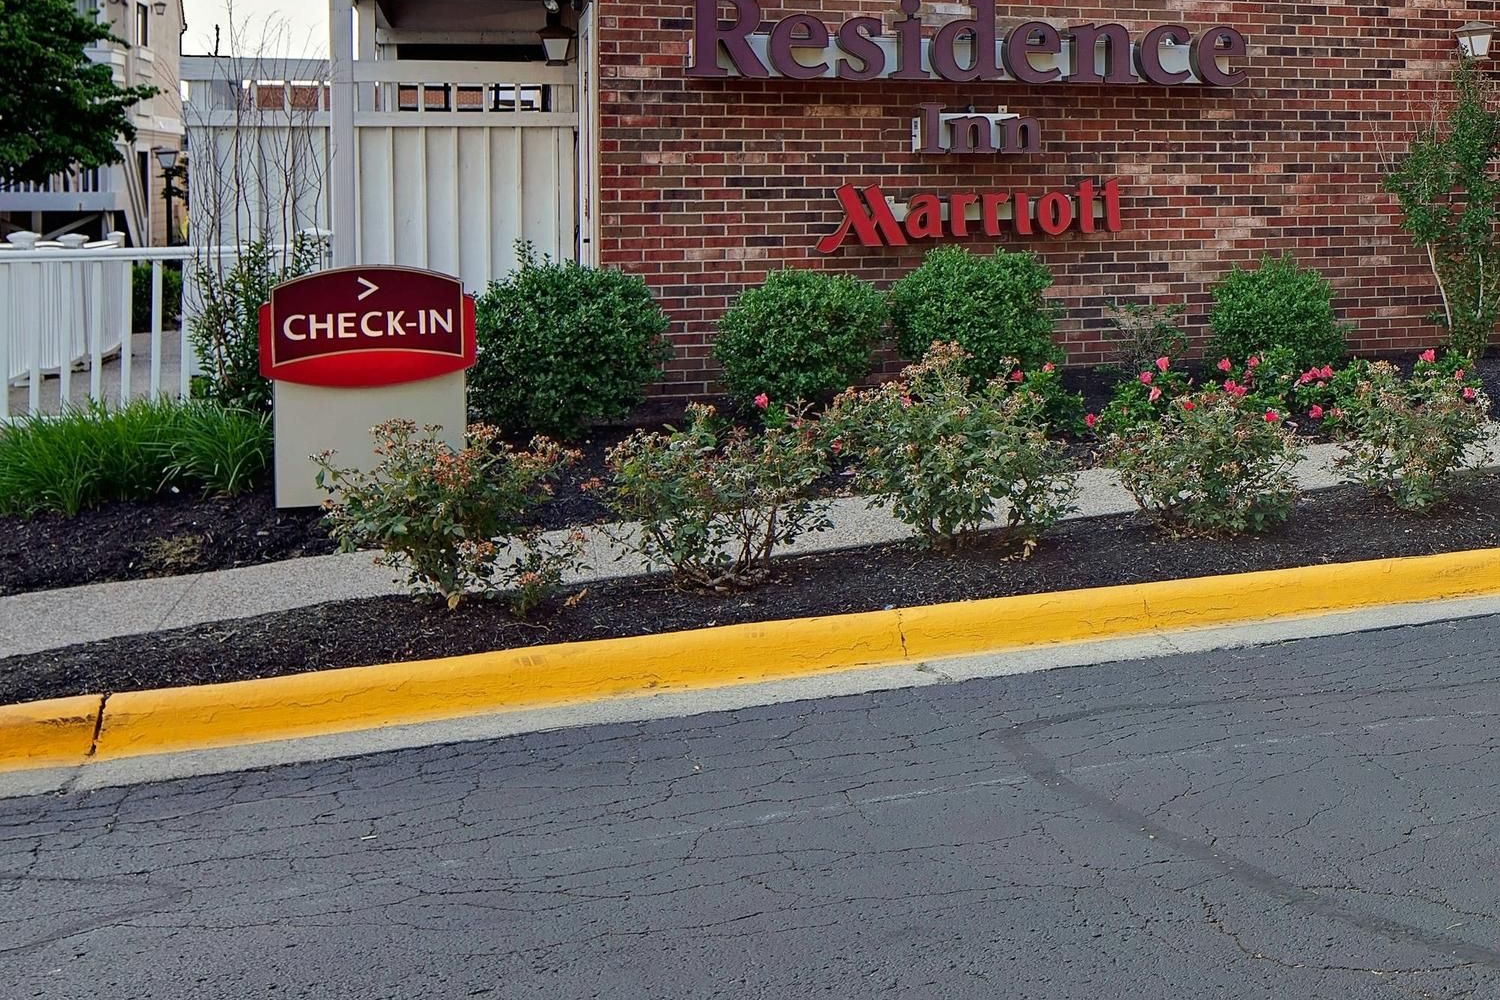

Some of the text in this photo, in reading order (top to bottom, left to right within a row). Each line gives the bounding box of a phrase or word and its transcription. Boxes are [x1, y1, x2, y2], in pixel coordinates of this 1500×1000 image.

[918, 101, 1043, 155] Inn
[814, 176, 1123, 253] Marriott
[283, 308, 453, 341] CHECK-IN
